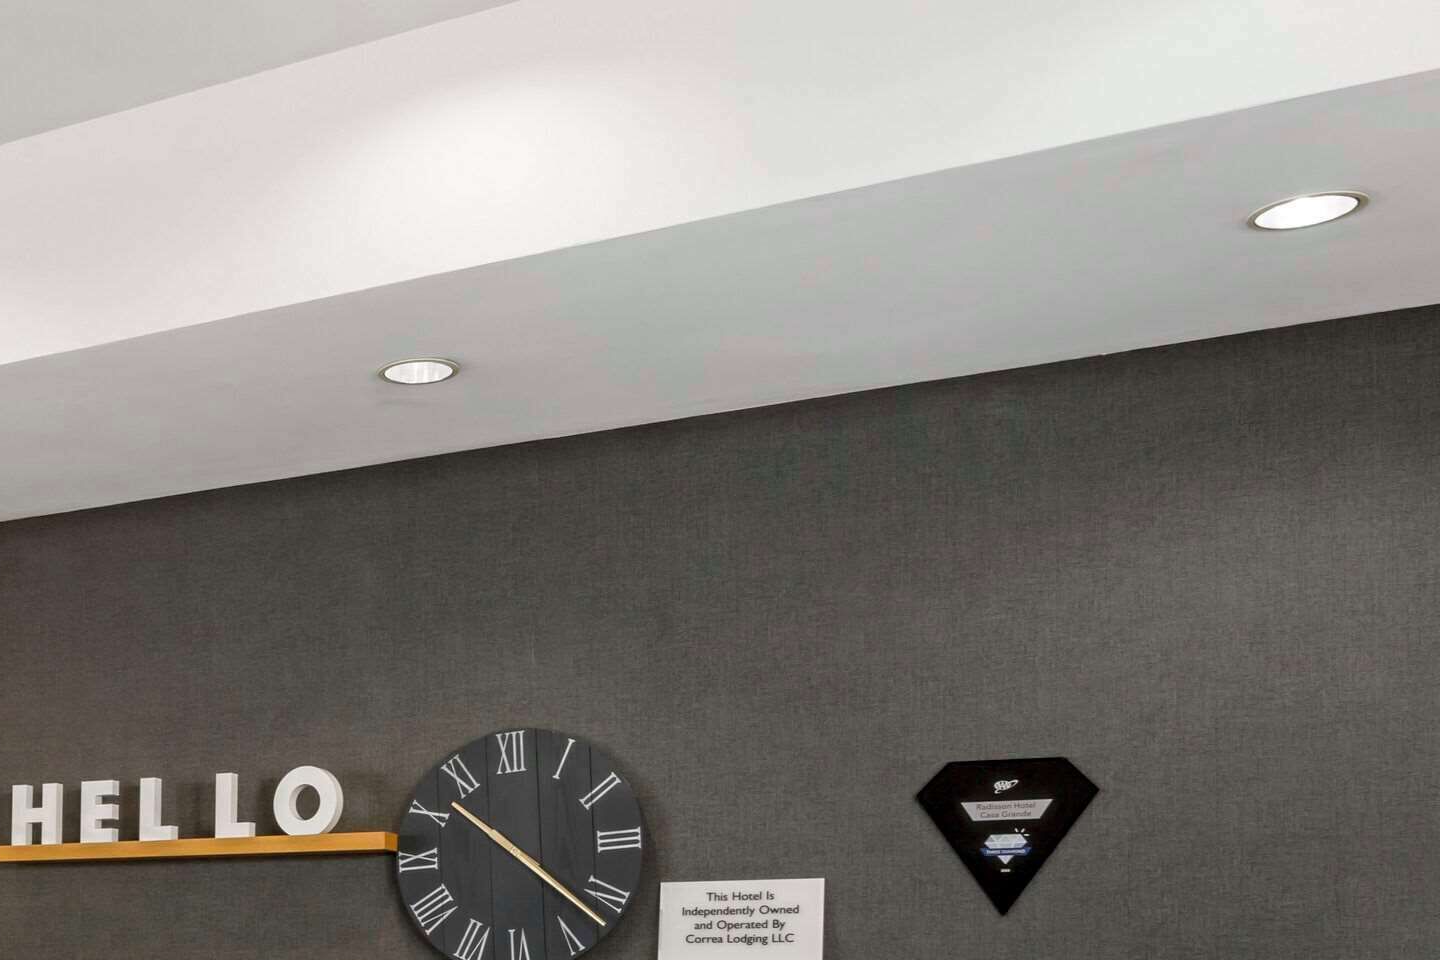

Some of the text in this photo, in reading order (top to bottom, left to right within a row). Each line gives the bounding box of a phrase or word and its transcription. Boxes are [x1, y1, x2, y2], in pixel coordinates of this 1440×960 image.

[496, 730, 527, 774] XII
[12, 765, 344, 846] HELLO
[976, 801, 1036, 811] Radisson Hotel
[1001, 810, 1032, 818] Grande
[706, 891, 775, 901] This Hotel Is
[682, 904, 800, 917] Independently Owned
[694, 919, 786, 932] and Operated By
[685, 933, 795, 945] Correa Lodging LLC
